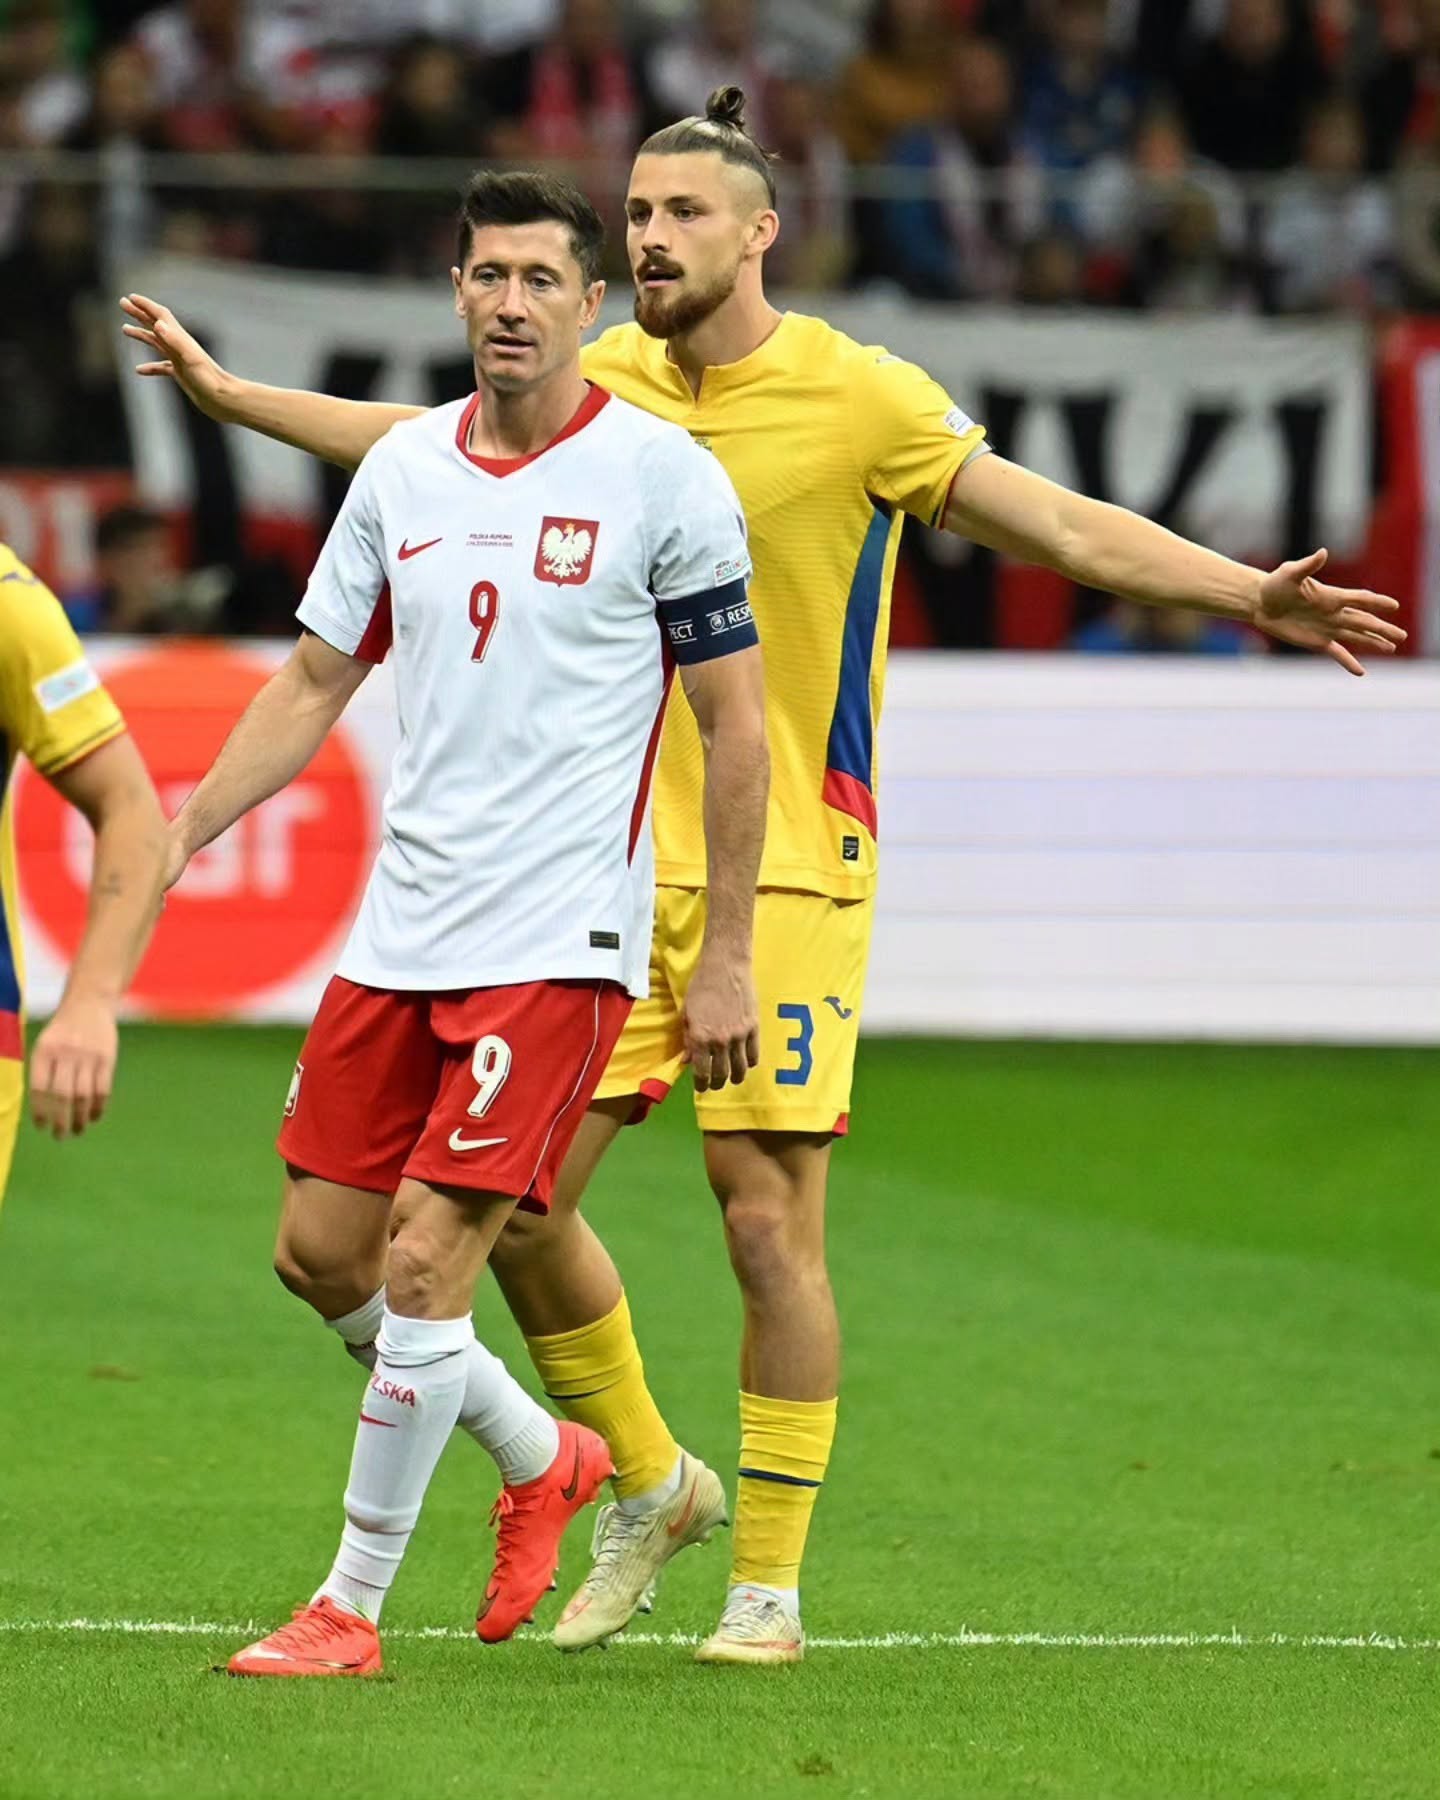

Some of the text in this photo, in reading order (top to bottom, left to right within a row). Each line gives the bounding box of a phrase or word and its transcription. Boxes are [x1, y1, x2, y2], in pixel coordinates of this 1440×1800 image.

[469, 580, 500, 663] 9
[467, 1034, 512, 1118] 9
[775, 1003, 814, 1086] 3
[372, 1374, 415, 1407] LSKA
